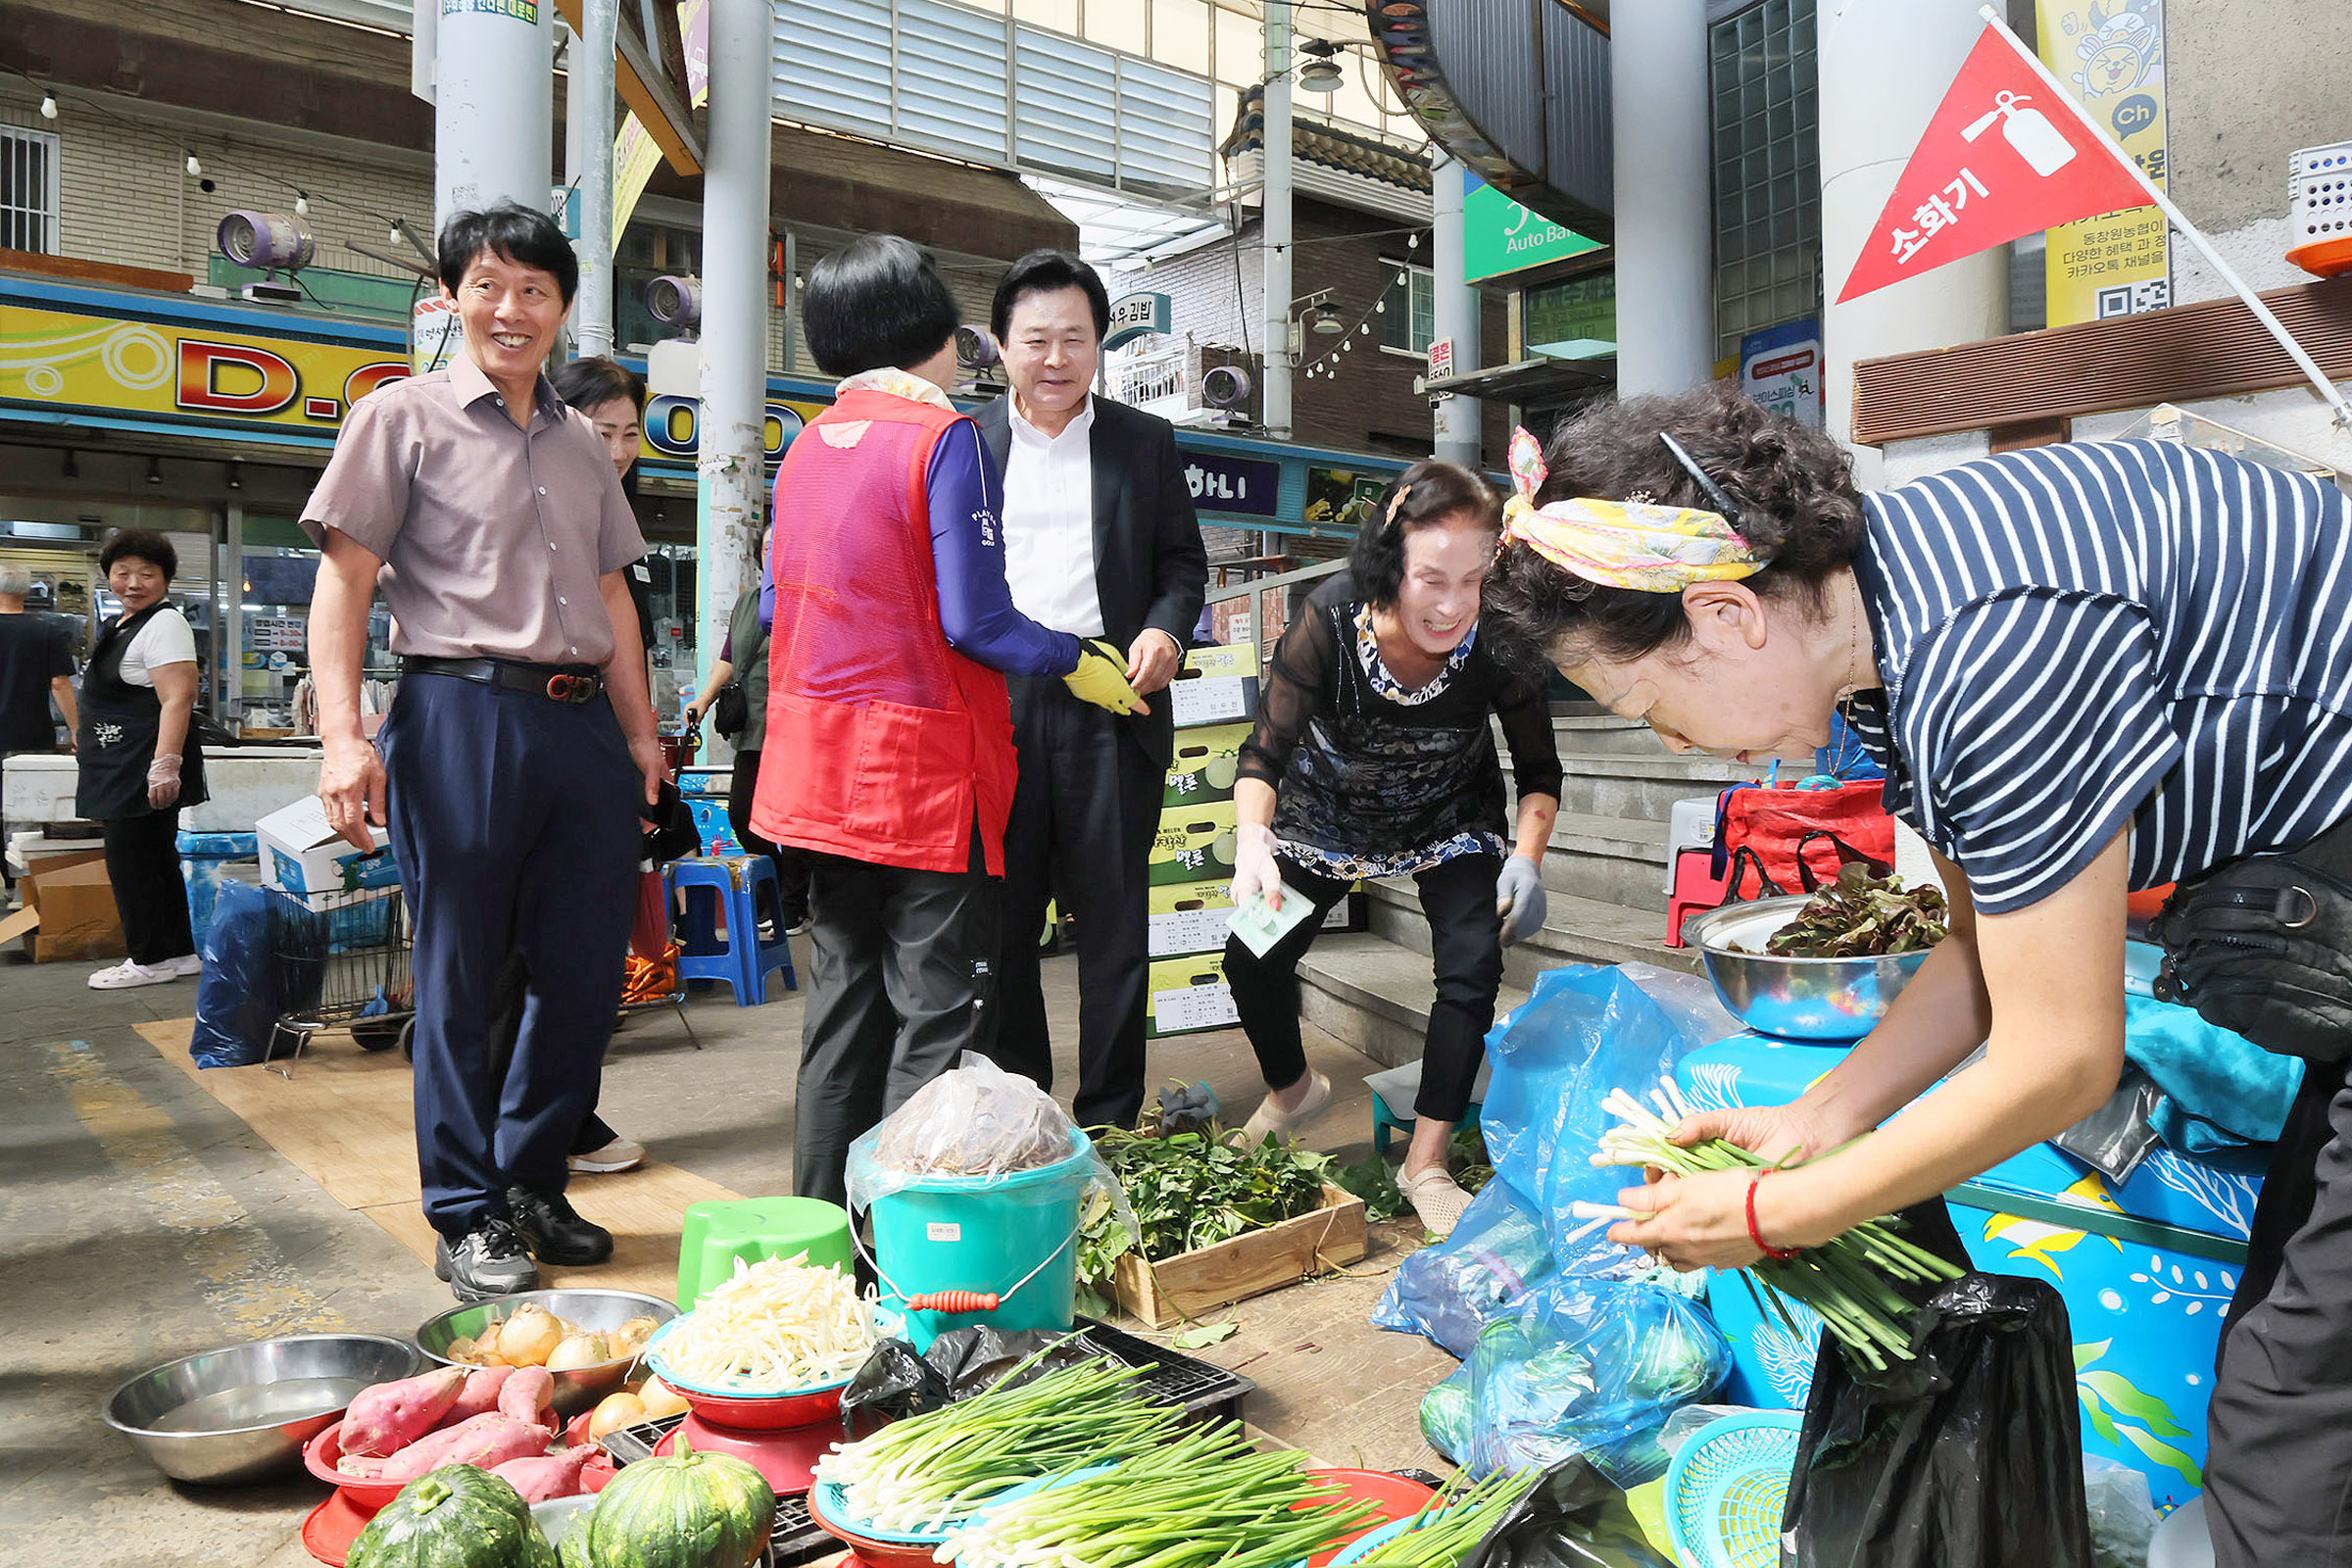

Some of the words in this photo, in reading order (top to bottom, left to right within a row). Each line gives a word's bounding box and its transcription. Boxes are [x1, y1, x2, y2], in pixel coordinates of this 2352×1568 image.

[2117, 104, 2150, 125] Ch
[1890, 167, 1990, 265] 소화기
[1505, 234, 1544, 254] Auto
[2083, 220, 2164, 246] 동창원농협이
[2063, 247, 2102, 265] 다양한
[2105, 240, 2132, 257] 혜택
[2136, 238, 2150, 252] 과
[2067, 260, 2120, 278] 카카오톡
[2124, 251, 2164, 269] 채널을
[1168, 773, 1199, 796] 멜론
[1176, 849, 1205, 871] 멜론
